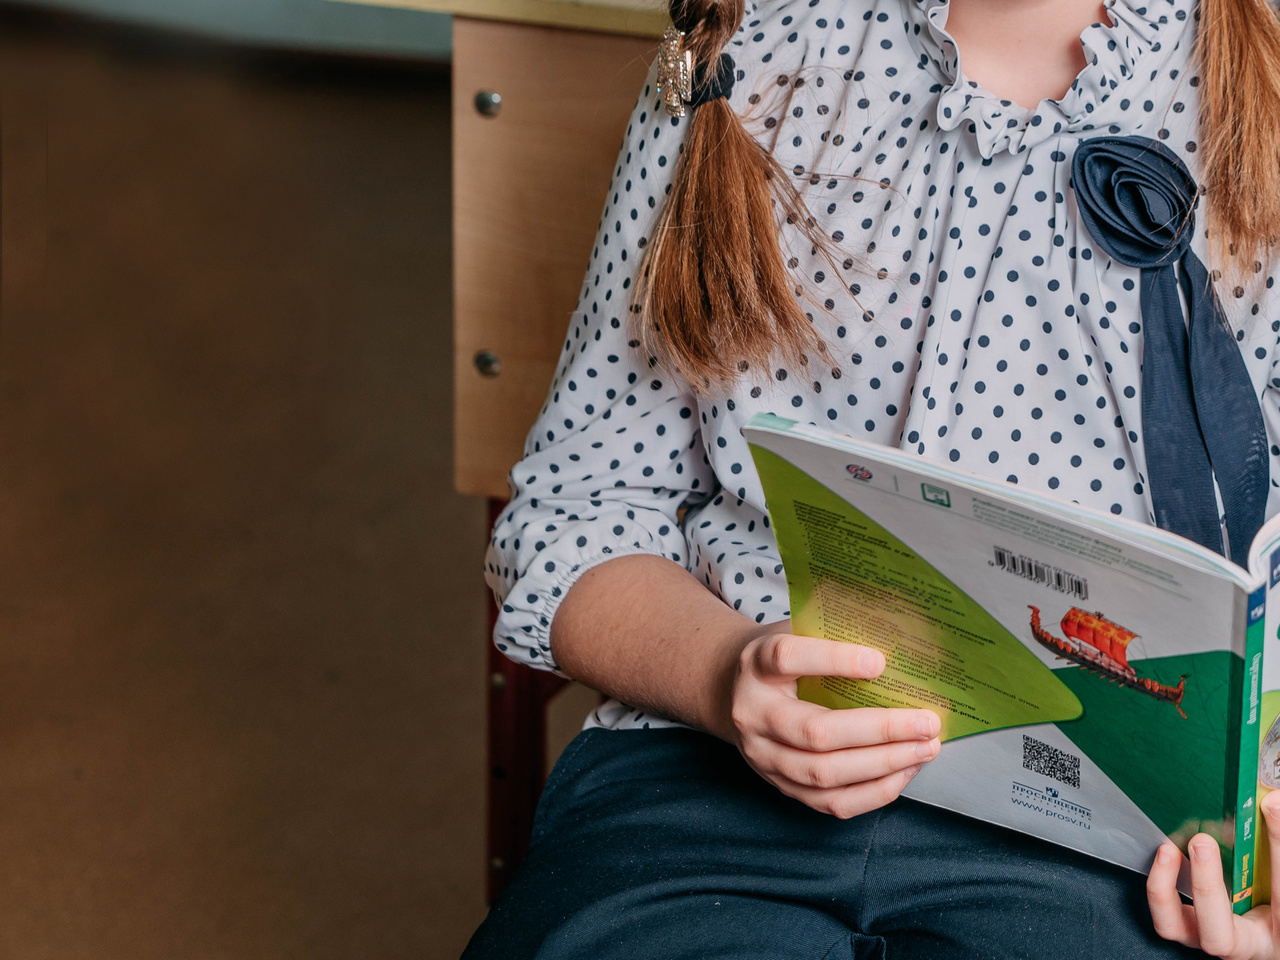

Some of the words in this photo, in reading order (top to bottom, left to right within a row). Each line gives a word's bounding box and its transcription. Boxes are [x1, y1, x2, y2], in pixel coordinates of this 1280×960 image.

[1249, 652, 1261, 709] Окружающий
[1247, 707, 1256, 725] мир
[1012, 784, 1092, 817] ПРОСВЕЩЕНИЕ
[1242, 796, 1253, 809] 4
[1011, 797, 1091, 830] www.prosv.ru
[1244, 816, 1253, 836] Часть
[1242, 853, 1250, 871] Школа
[1241, 869, 1249, 889] России
